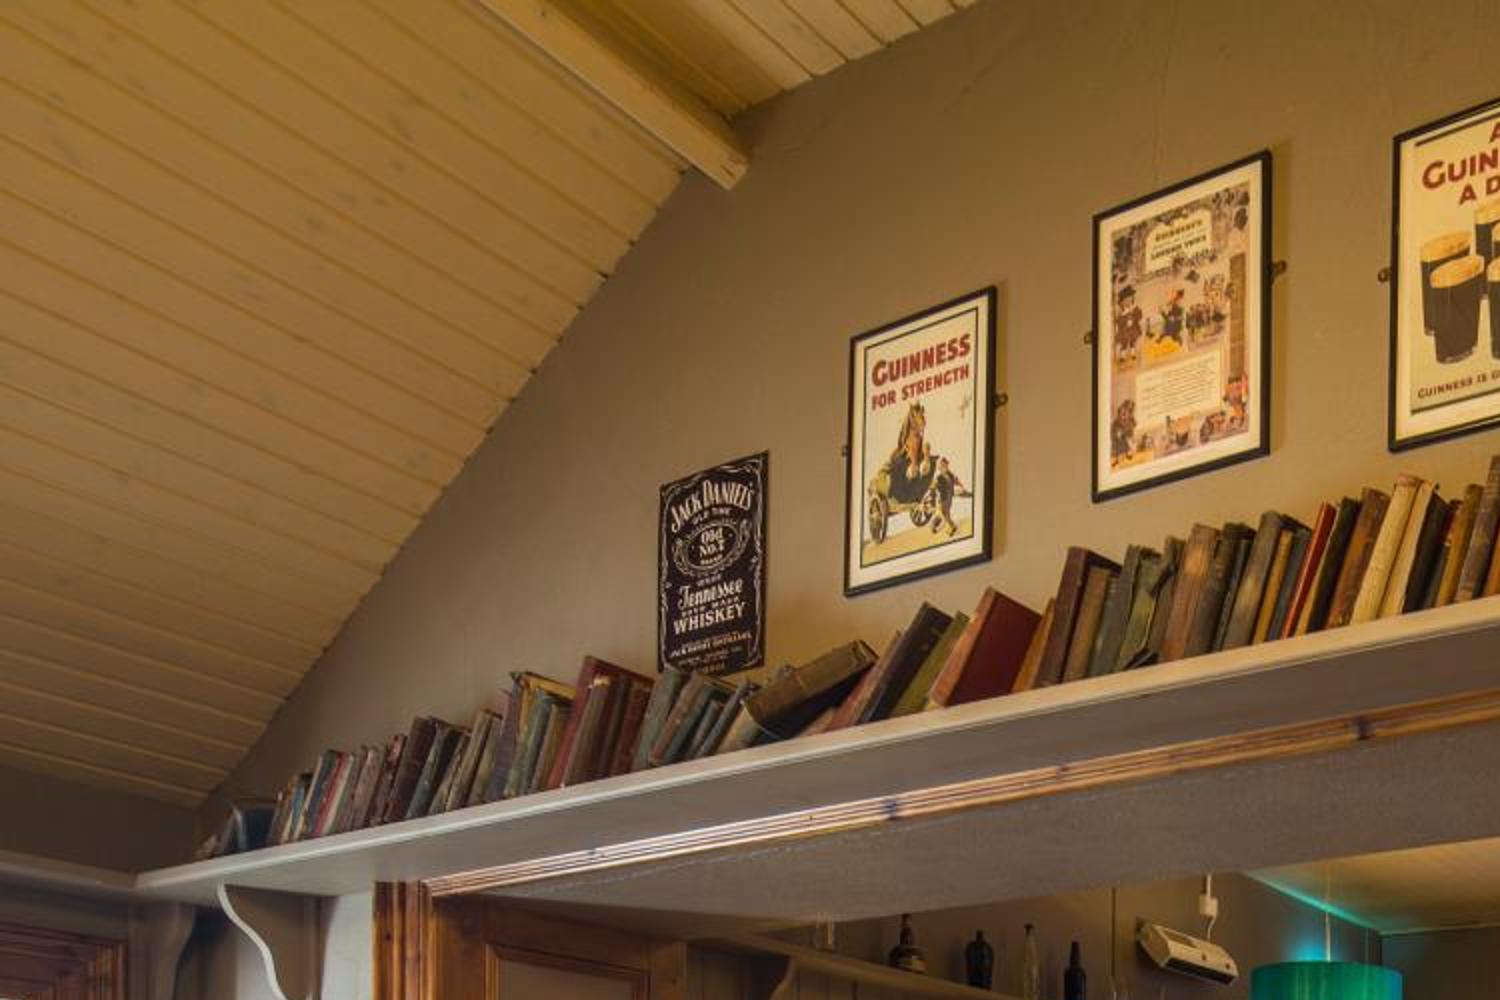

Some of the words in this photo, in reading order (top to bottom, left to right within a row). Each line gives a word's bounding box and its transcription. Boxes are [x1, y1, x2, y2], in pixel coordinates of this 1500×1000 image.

[1459, 184, 1477, 205] A
[872, 333, 971, 387] GUINNESS
[872, 390, 897, 411] FOR
[902, 364, 969, 401] STRENGTH
[1417, 376, 1473, 399] GUINNESS
[1477, 373, 1488, 383] IS
[672, 489, 702, 533] JACK
[677, 578, 743, 611] Tennessee
[674, 602, 746, 635] WHISKEY
